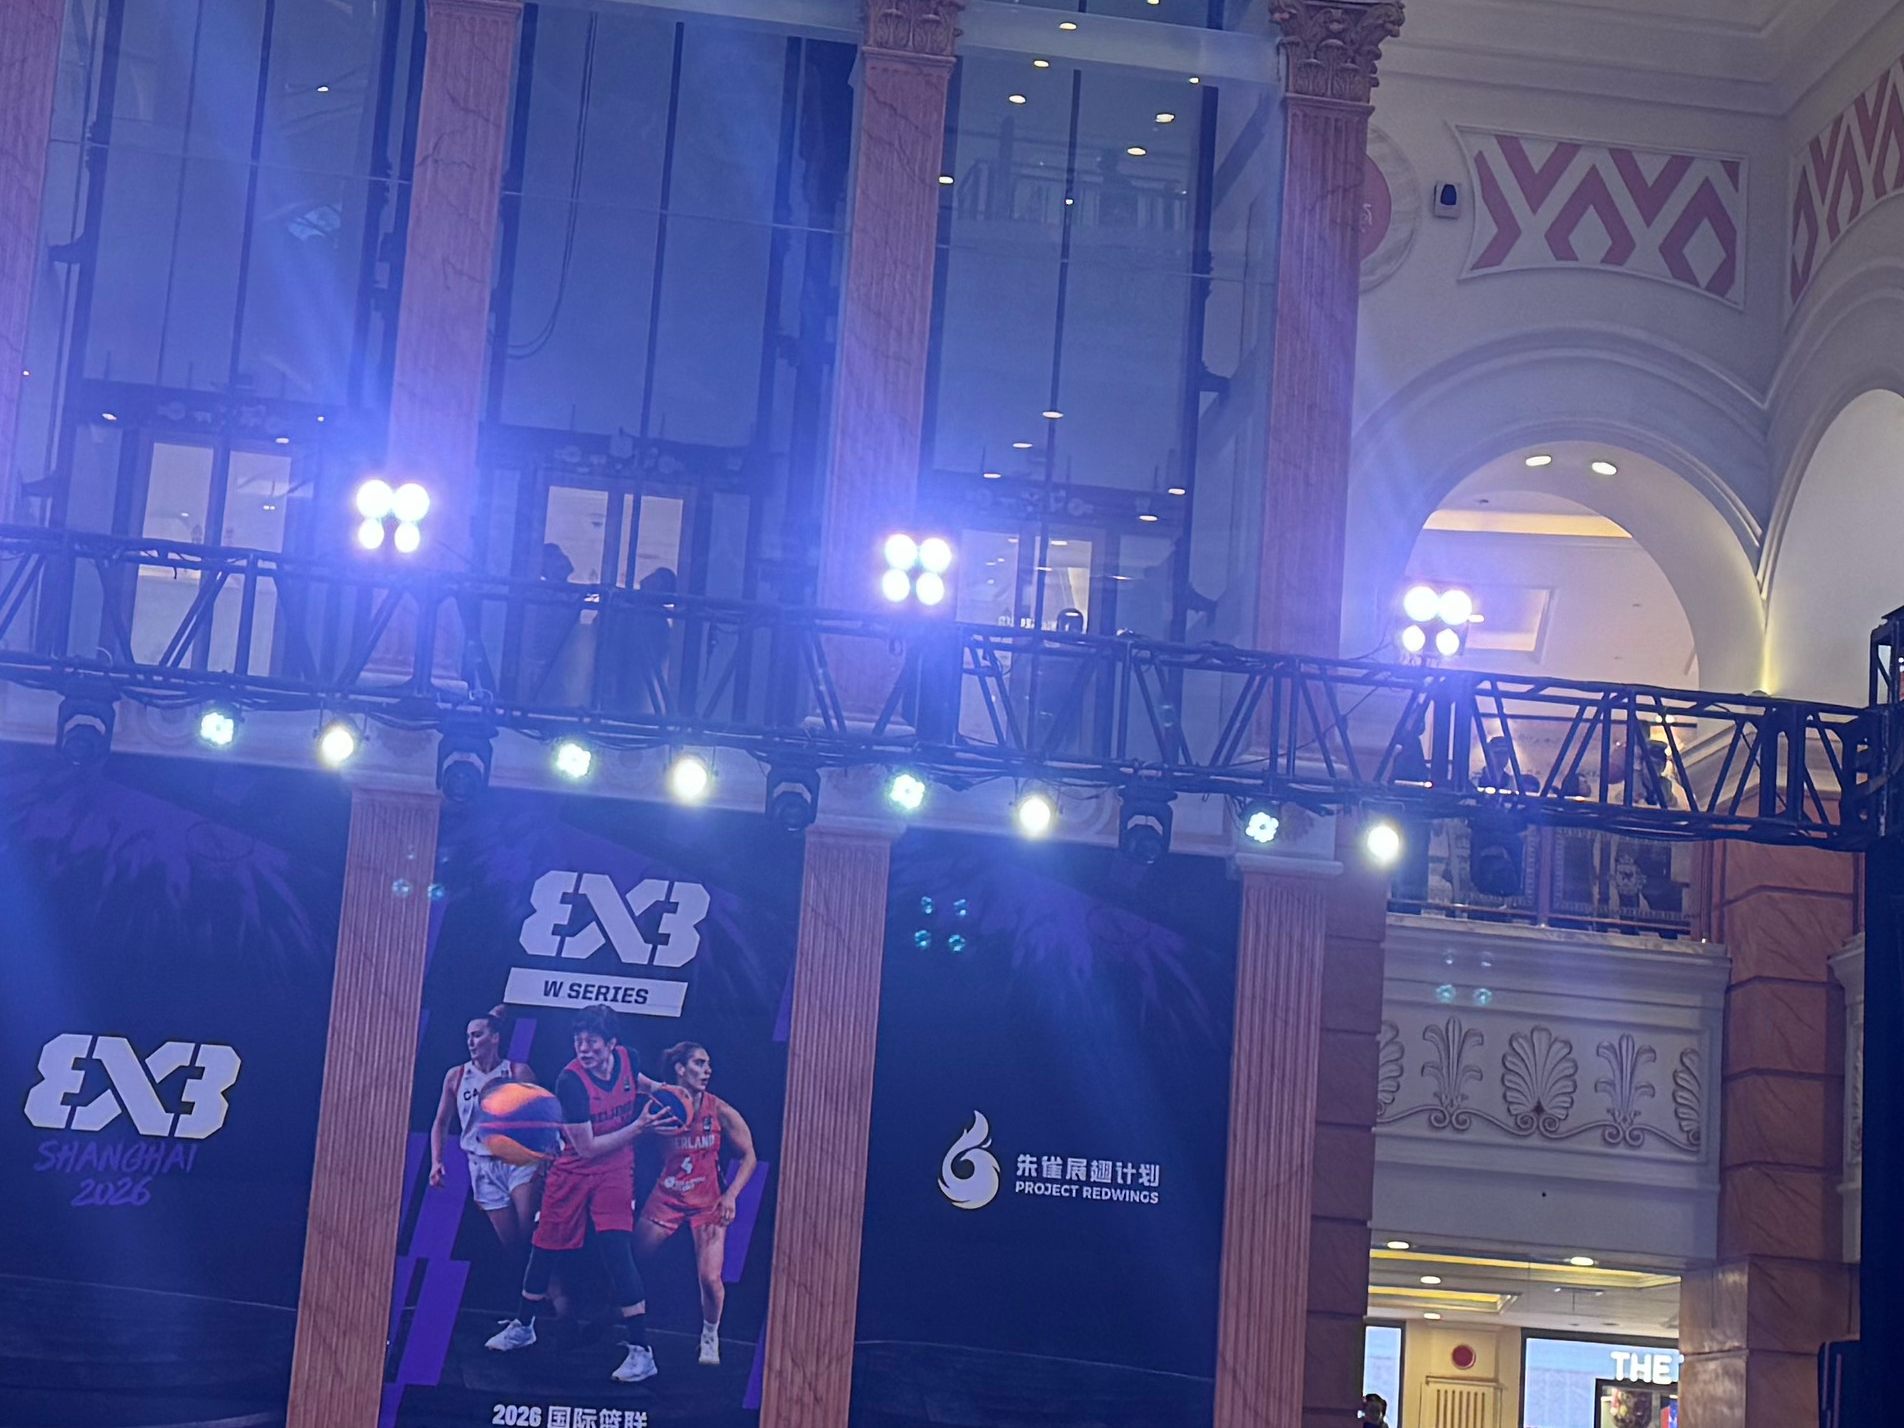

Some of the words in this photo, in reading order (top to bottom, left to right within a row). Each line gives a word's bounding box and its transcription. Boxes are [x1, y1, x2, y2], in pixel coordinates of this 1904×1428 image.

[543, 980, 563, 997] W
[567, 982, 649, 1004] SERIES
[32, 1138, 201, 1175] SHANGHAI
[1016, 1153, 1160, 1187] 朱雀展翅计划
[70, 1175, 154, 1207] 2026
[1015, 1181, 1079, 1198] PROJECT
[1082, 1186, 1159, 1204] REDWINGS
[1610, 1351, 1673, 1385] THE
[492, 1404, 542, 1427] 2026
